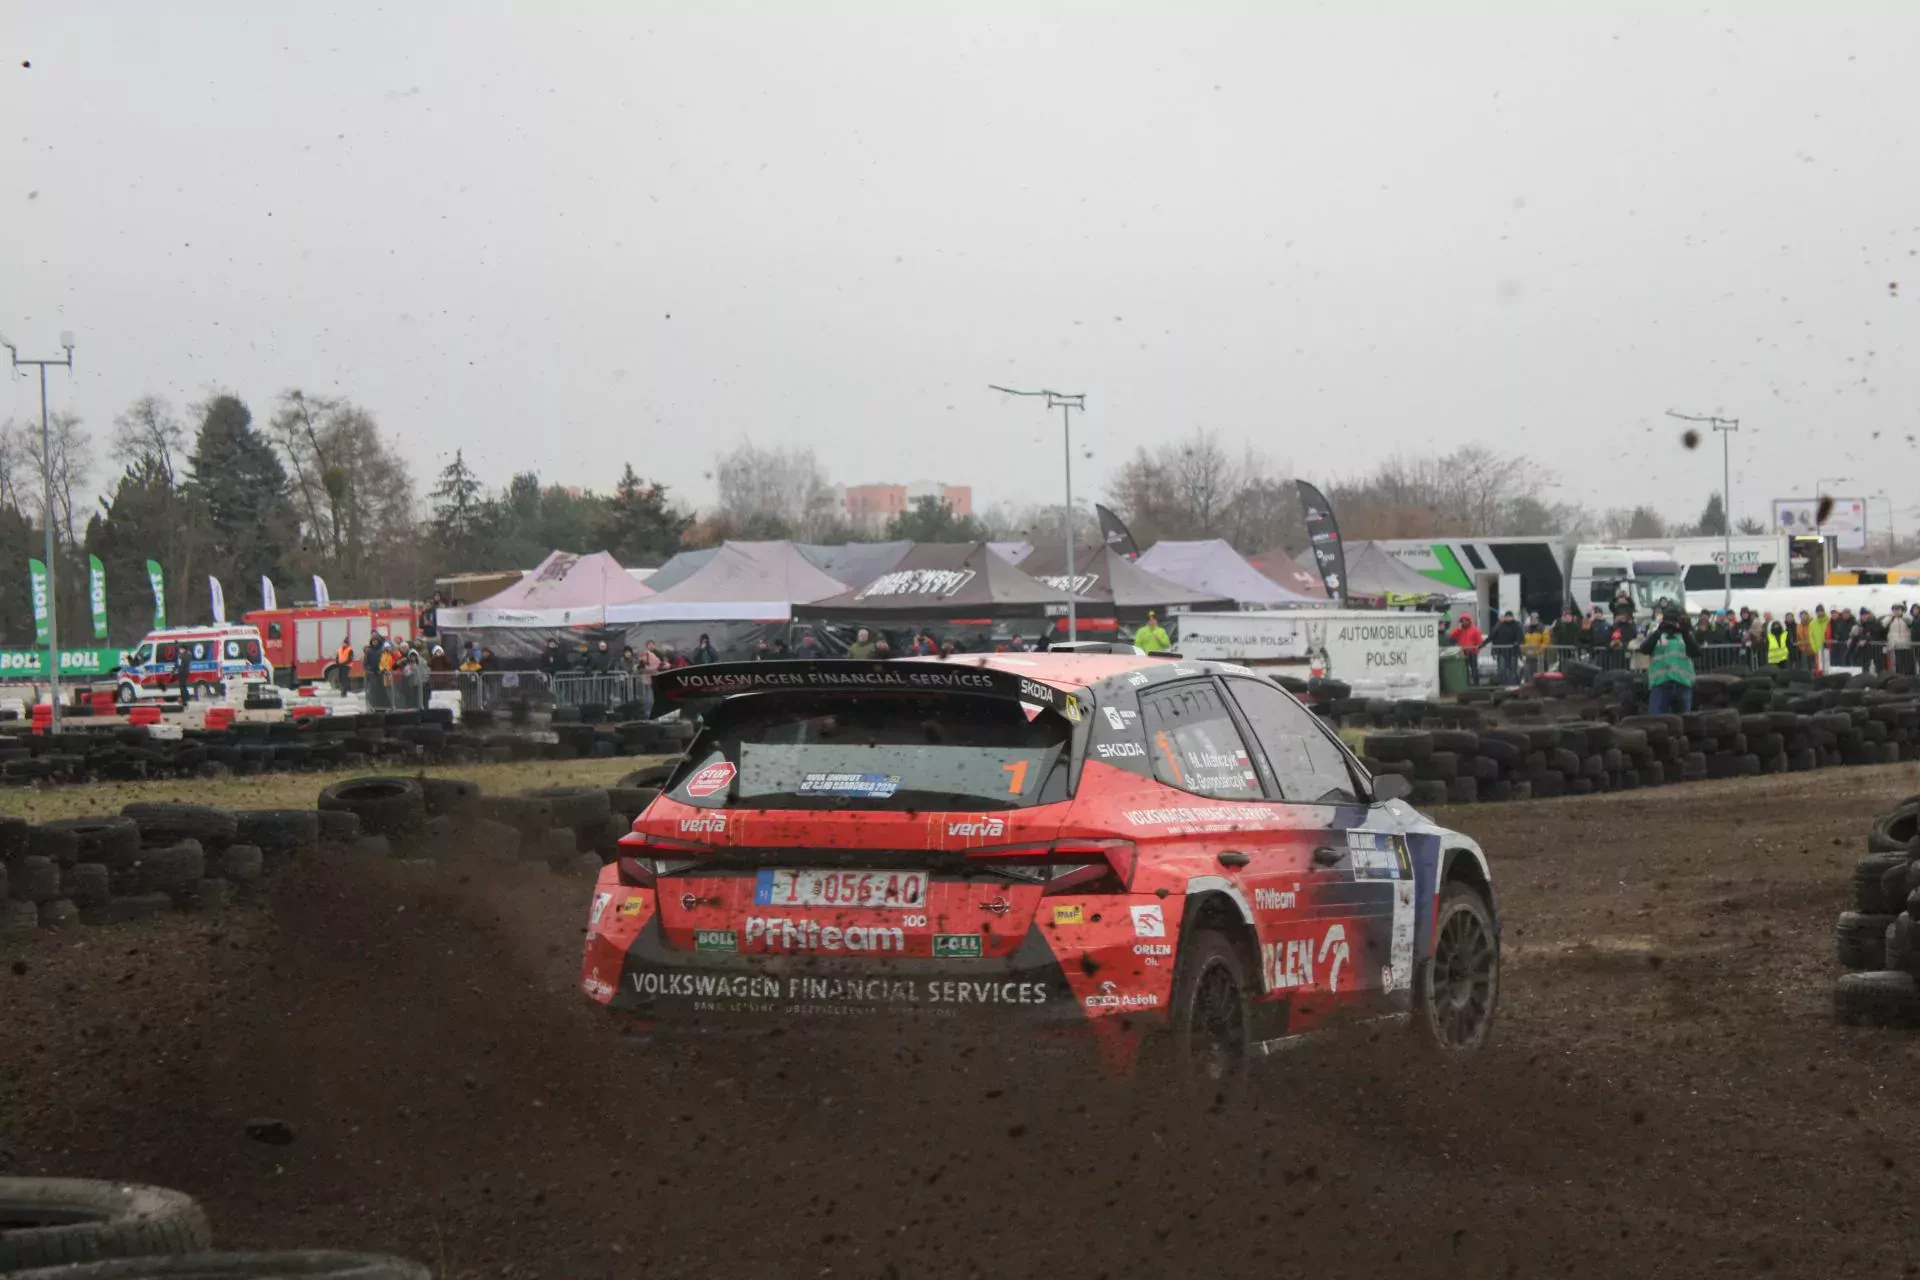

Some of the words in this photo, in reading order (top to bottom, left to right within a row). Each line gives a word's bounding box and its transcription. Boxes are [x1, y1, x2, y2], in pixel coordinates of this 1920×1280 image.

[31, 573, 48, 621] BOLL
[91, 569, 105, 615] BOLL
[1338, 625, 1435, 641] AUTOMOBILKLUB
[0, 652, 42, 669] BOLL
[60, 652, 100, 668] BOLL
[1366, 651, 1407, 666] POLSKI
[676, 673, 804, 688] VOLKSWAGEN
[808, 671, 906, 685] FINANCIAL
[910, 673, 994, 688] SERVICES
[1003, 760, 1028, 794] 1
[1122, 808, 1200, 826] VOLKSWAGEN
[681, 818, 726, 833] verva
[948, 821, 1004, 837] verva
[903, 914, 928, 928] 100
[699, 931, 735, 945] BOLL
[1133, 944, 1171, 955] ORLEN
[632, 971, 780, 998] VOLKSWAGEN
[789, 978, 918, 1000] FINANCIAL
[927, 982, 1047, 1004] SERVICES
